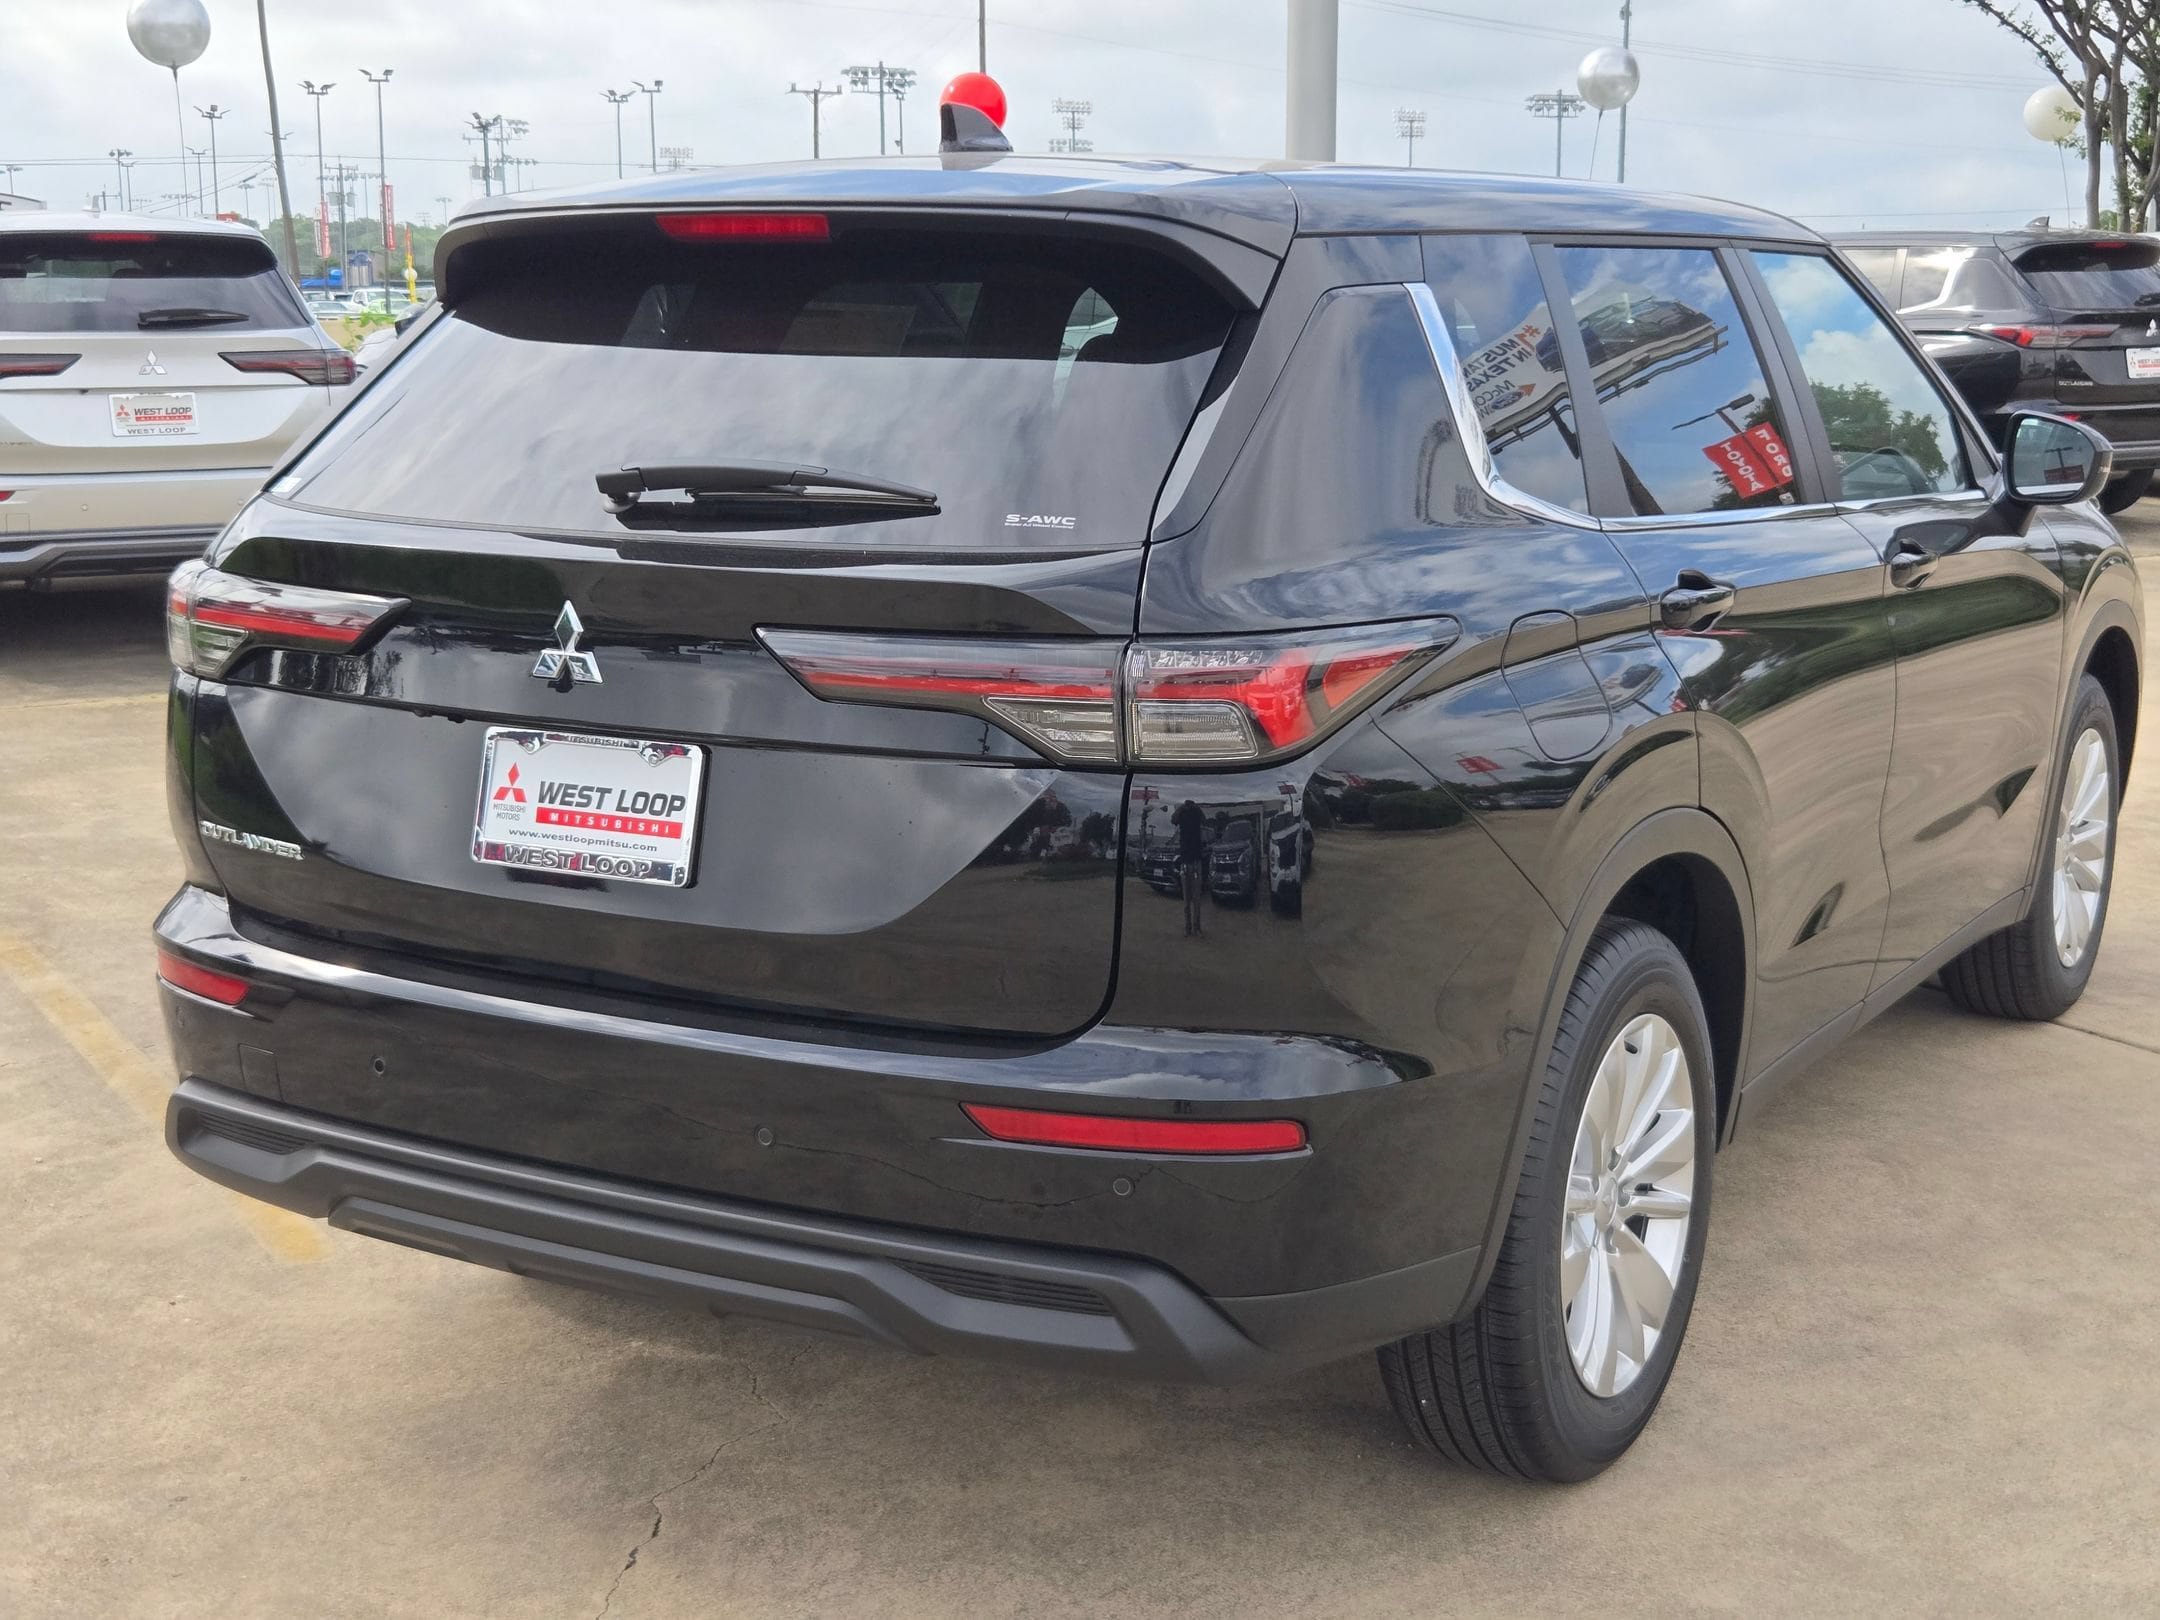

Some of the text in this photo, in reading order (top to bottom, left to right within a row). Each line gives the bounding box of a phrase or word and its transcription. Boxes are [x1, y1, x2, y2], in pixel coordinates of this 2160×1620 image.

[165, 407, 192, 415] LOOP
[1006, 514, 1076, 525] S-AWC
[493, 803, 527, 813] MITSUBISHI
[538, 781, 686, 817] WEST LOOP
[496, 812, 520, 821] MOTORS
[550, 813, 669, 834] MITSUBISHI
[200, 820, 304, 860] OUTLANDER
[509, 829, 658, 851] www.westloopmitsu.com
[504, 843, 652, 879] WEST LOOP
